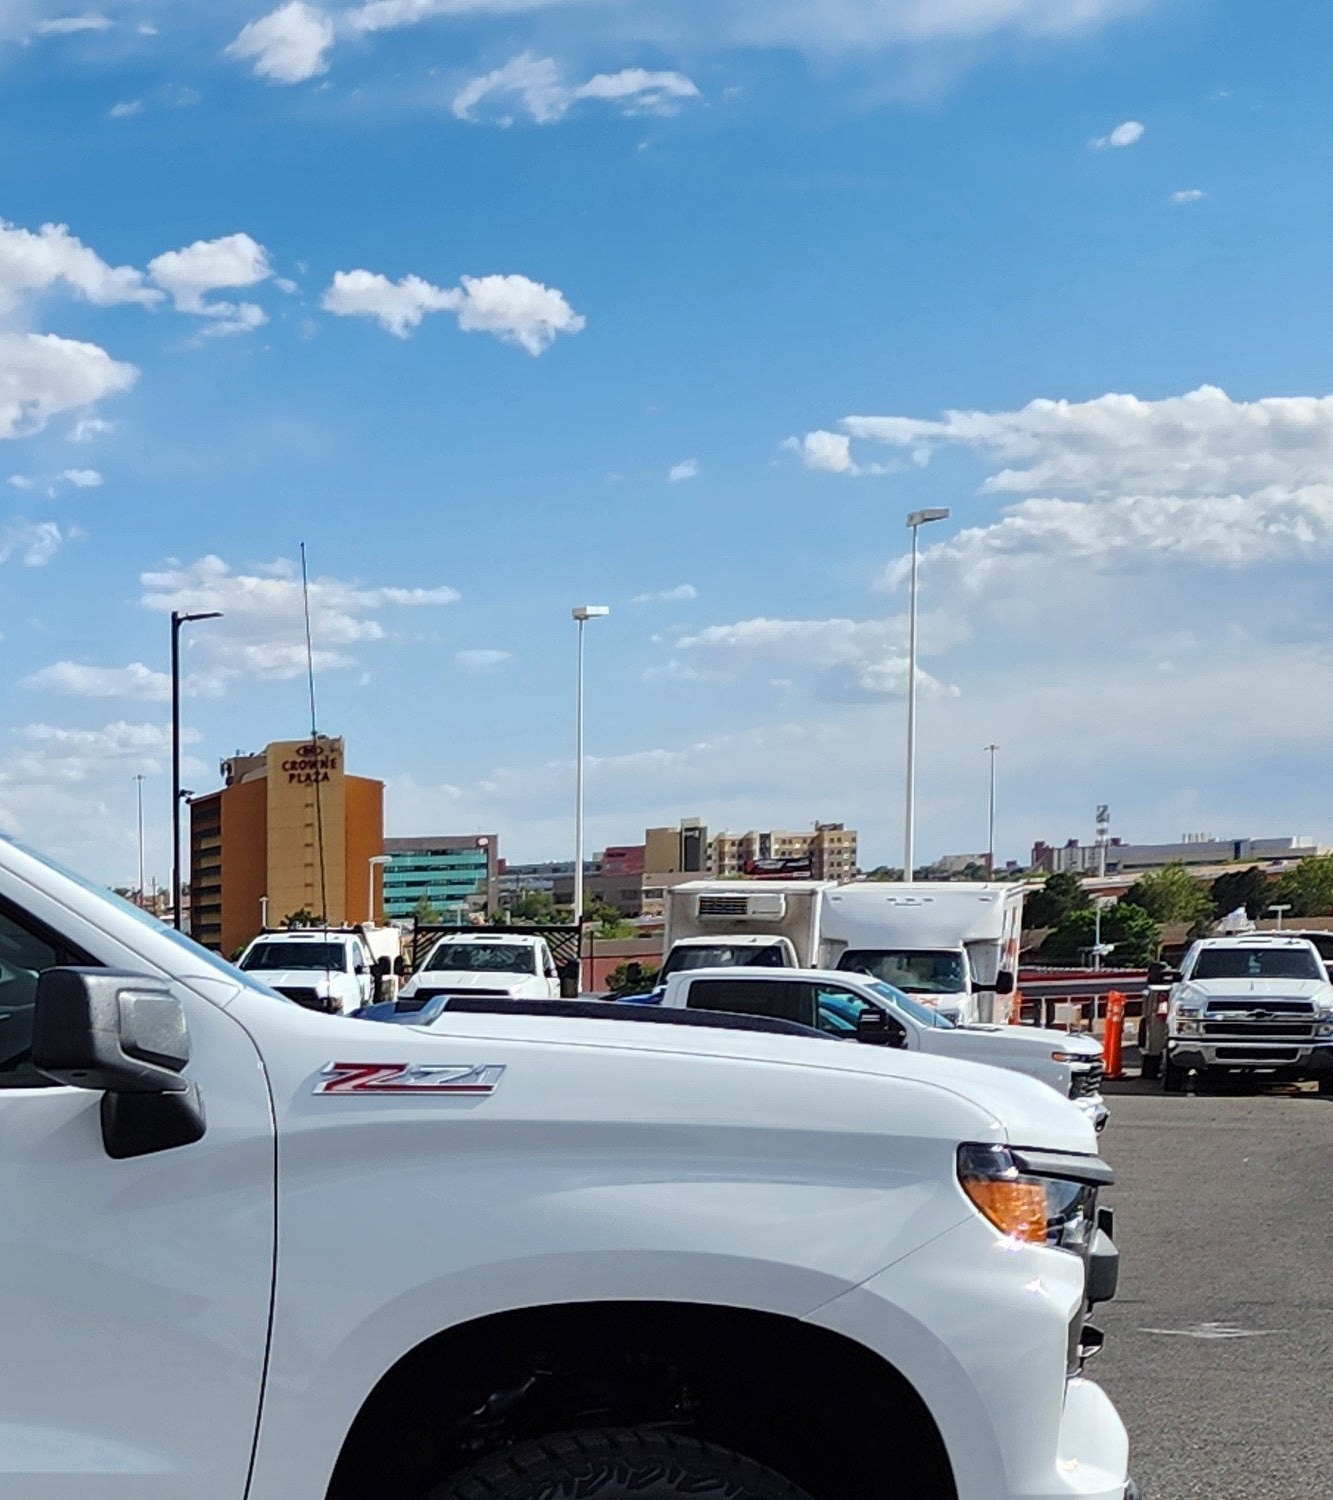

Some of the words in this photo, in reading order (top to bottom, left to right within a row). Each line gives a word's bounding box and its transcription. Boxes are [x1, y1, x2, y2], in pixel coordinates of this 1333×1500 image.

[282, 758, 338, 771] CROWNE
[289, 771, 330, 784] PLAZA
[312, 1061, 507, 1096] Z71
